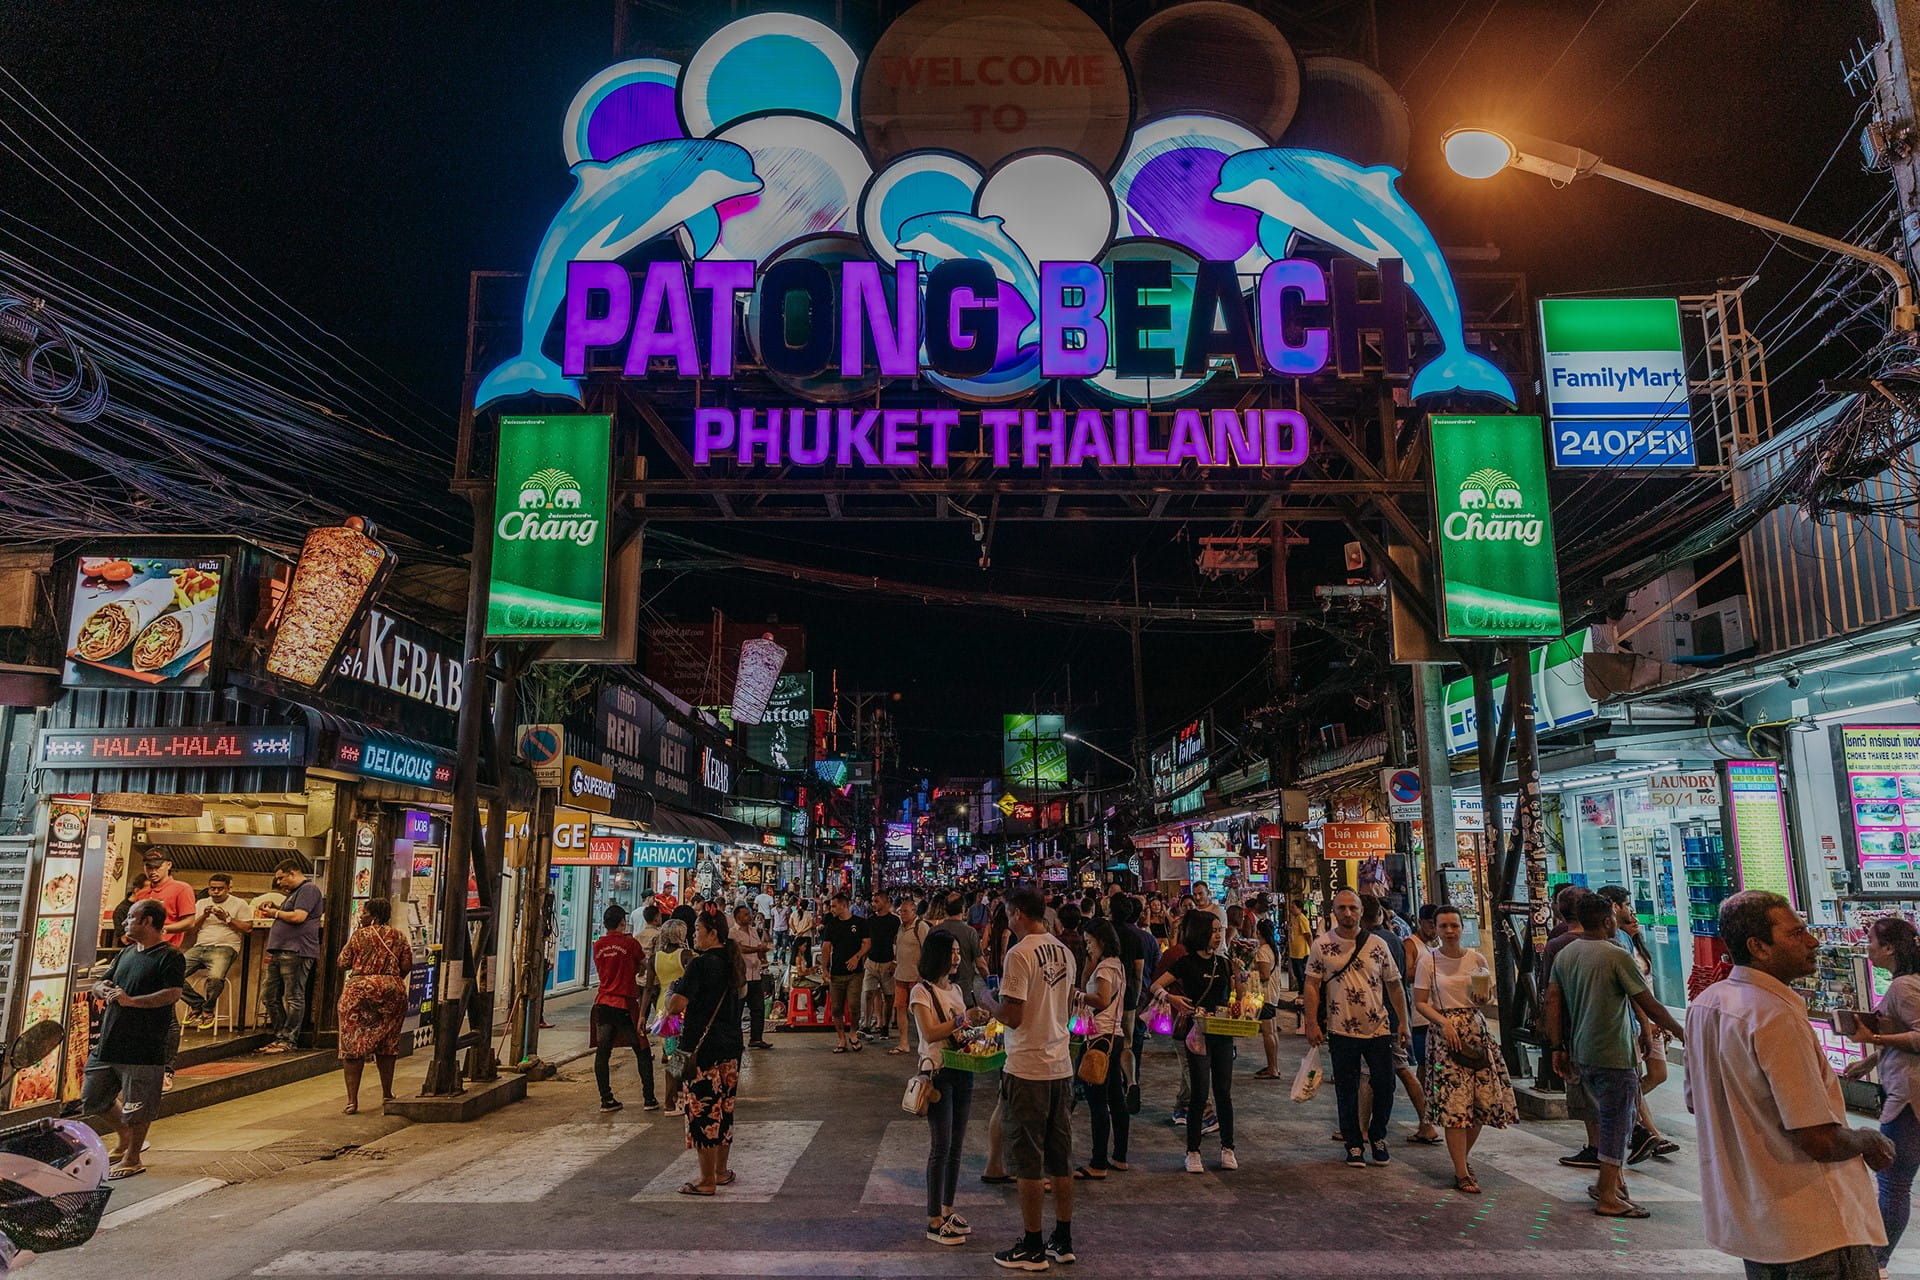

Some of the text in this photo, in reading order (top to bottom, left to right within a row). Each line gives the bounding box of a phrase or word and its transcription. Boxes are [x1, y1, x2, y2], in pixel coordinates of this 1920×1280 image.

[881, 55, 1105, 86] WELCOME
[962, 104, 1027, 134] TO
[561, 257, 1410, 379] PATONG BEACH
[1552, 367, 1683, 392] FamilyMart
[694, 408, 1309, 467] PHUKET THAILAND
[497, 511, 599, 546] Chang
[1443, 511, 1544, 546] Chang
[364, 610, 463, 712] KEBAB
[762, 707, 809, 723] attoo
[92, 736, 242, 757] HALAL-HALAL
[606, 712, 642, 759] RENT
[363, 745, 433, 781] DELICIOUS
[660, 736, 687, 775] RENT
[704, 746, 729, 794] KEBAB
[1010, 741, 1067, 780] SINGHA
[1847, 752, 1919, 760] CHOKE THAVEE CAR RENT
[1651, 775, 1717, 789] LAUNDRY
[1460, 799, 1514, 809] Famiart
[1652, 793, 1693, 806] 50/1
[414, 819, 428, 832] UOB
[588, 852, 613, 860] AILOR
[1327, 841, 1359, 849] Chai
[1361, 841, 1387, 849] Dee
[1034, 944, 1066, 967] UNIT
